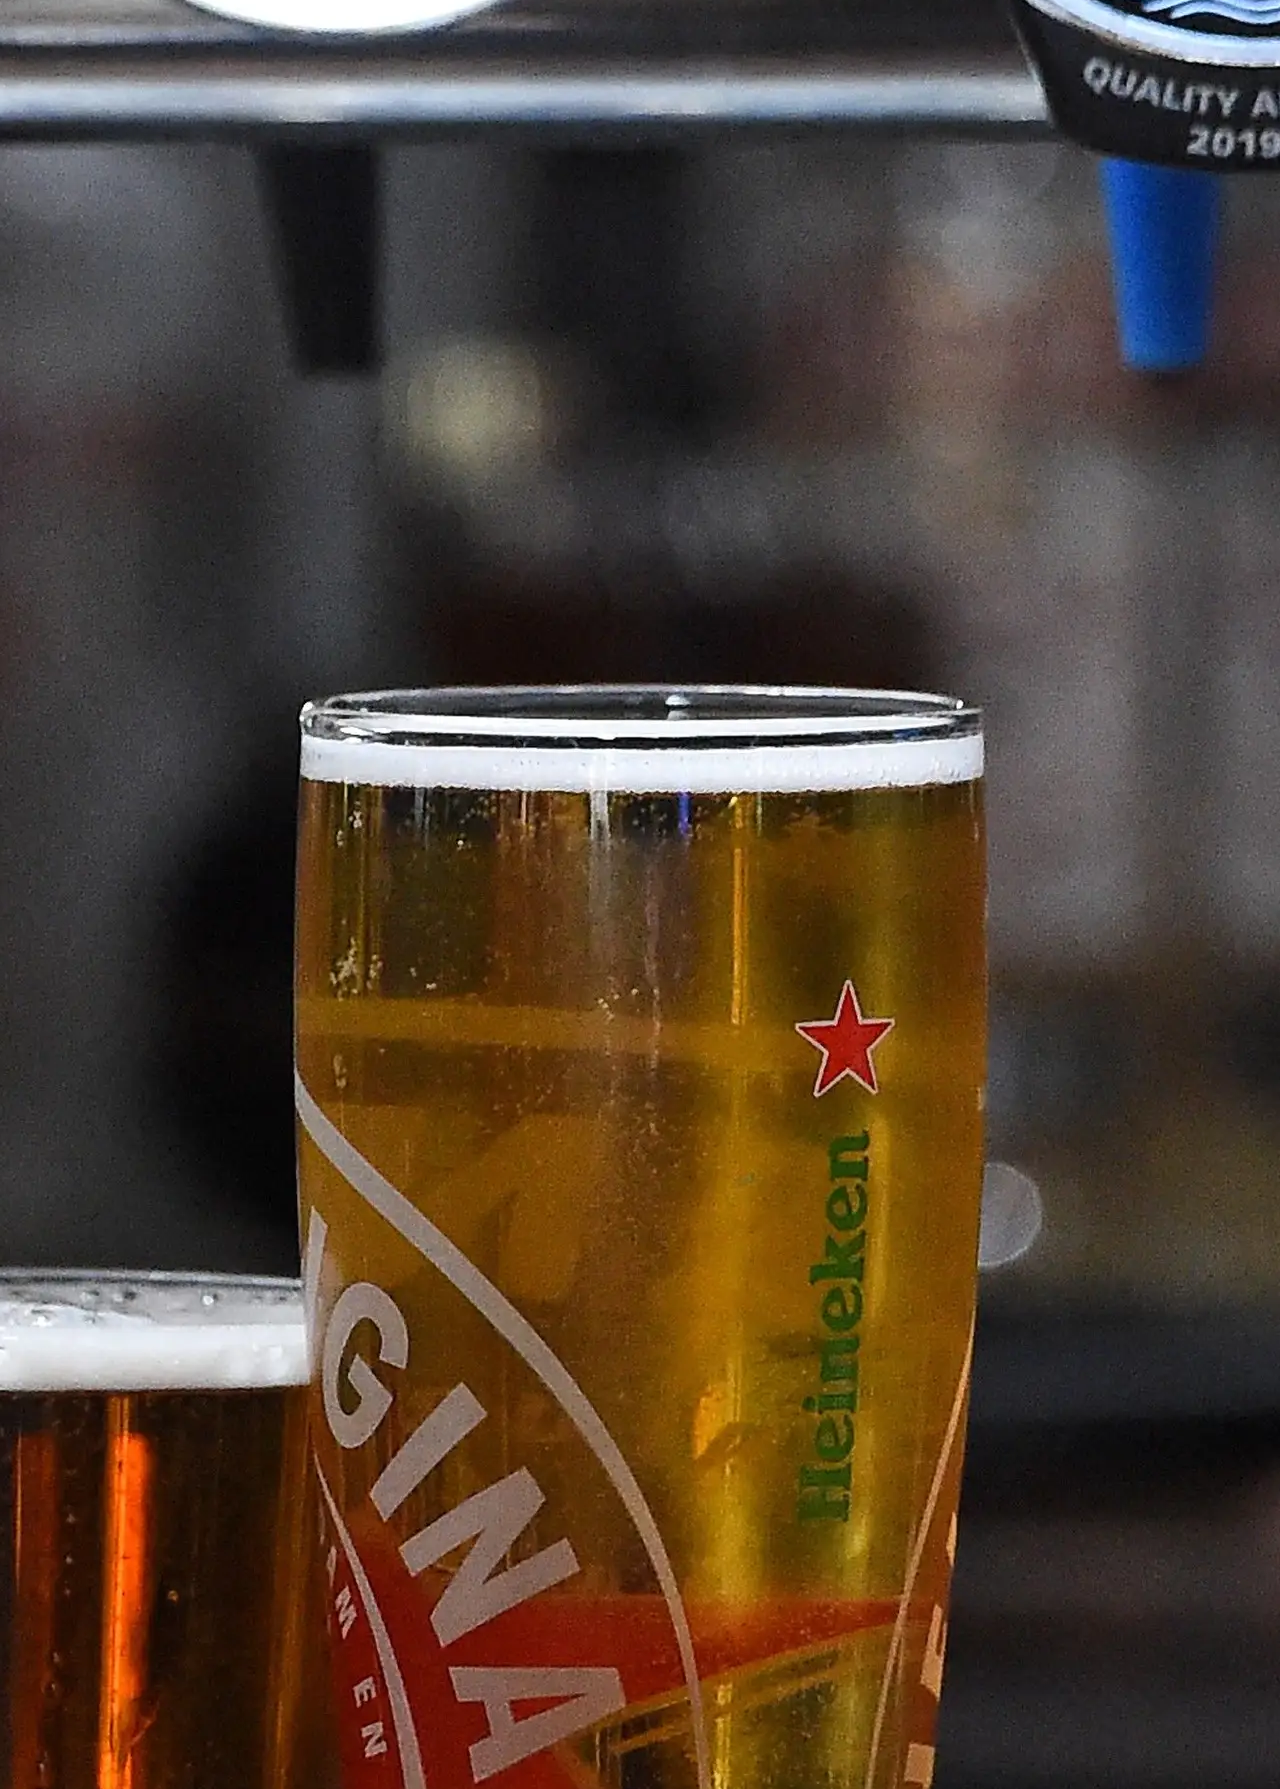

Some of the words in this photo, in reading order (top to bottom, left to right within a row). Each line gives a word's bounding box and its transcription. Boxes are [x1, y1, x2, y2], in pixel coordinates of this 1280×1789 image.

[1082, 56, 1239, 116] QUALITY
[796, 1129, 870, 1524] Heineken
[353, 1675, 388, 1758] EN
